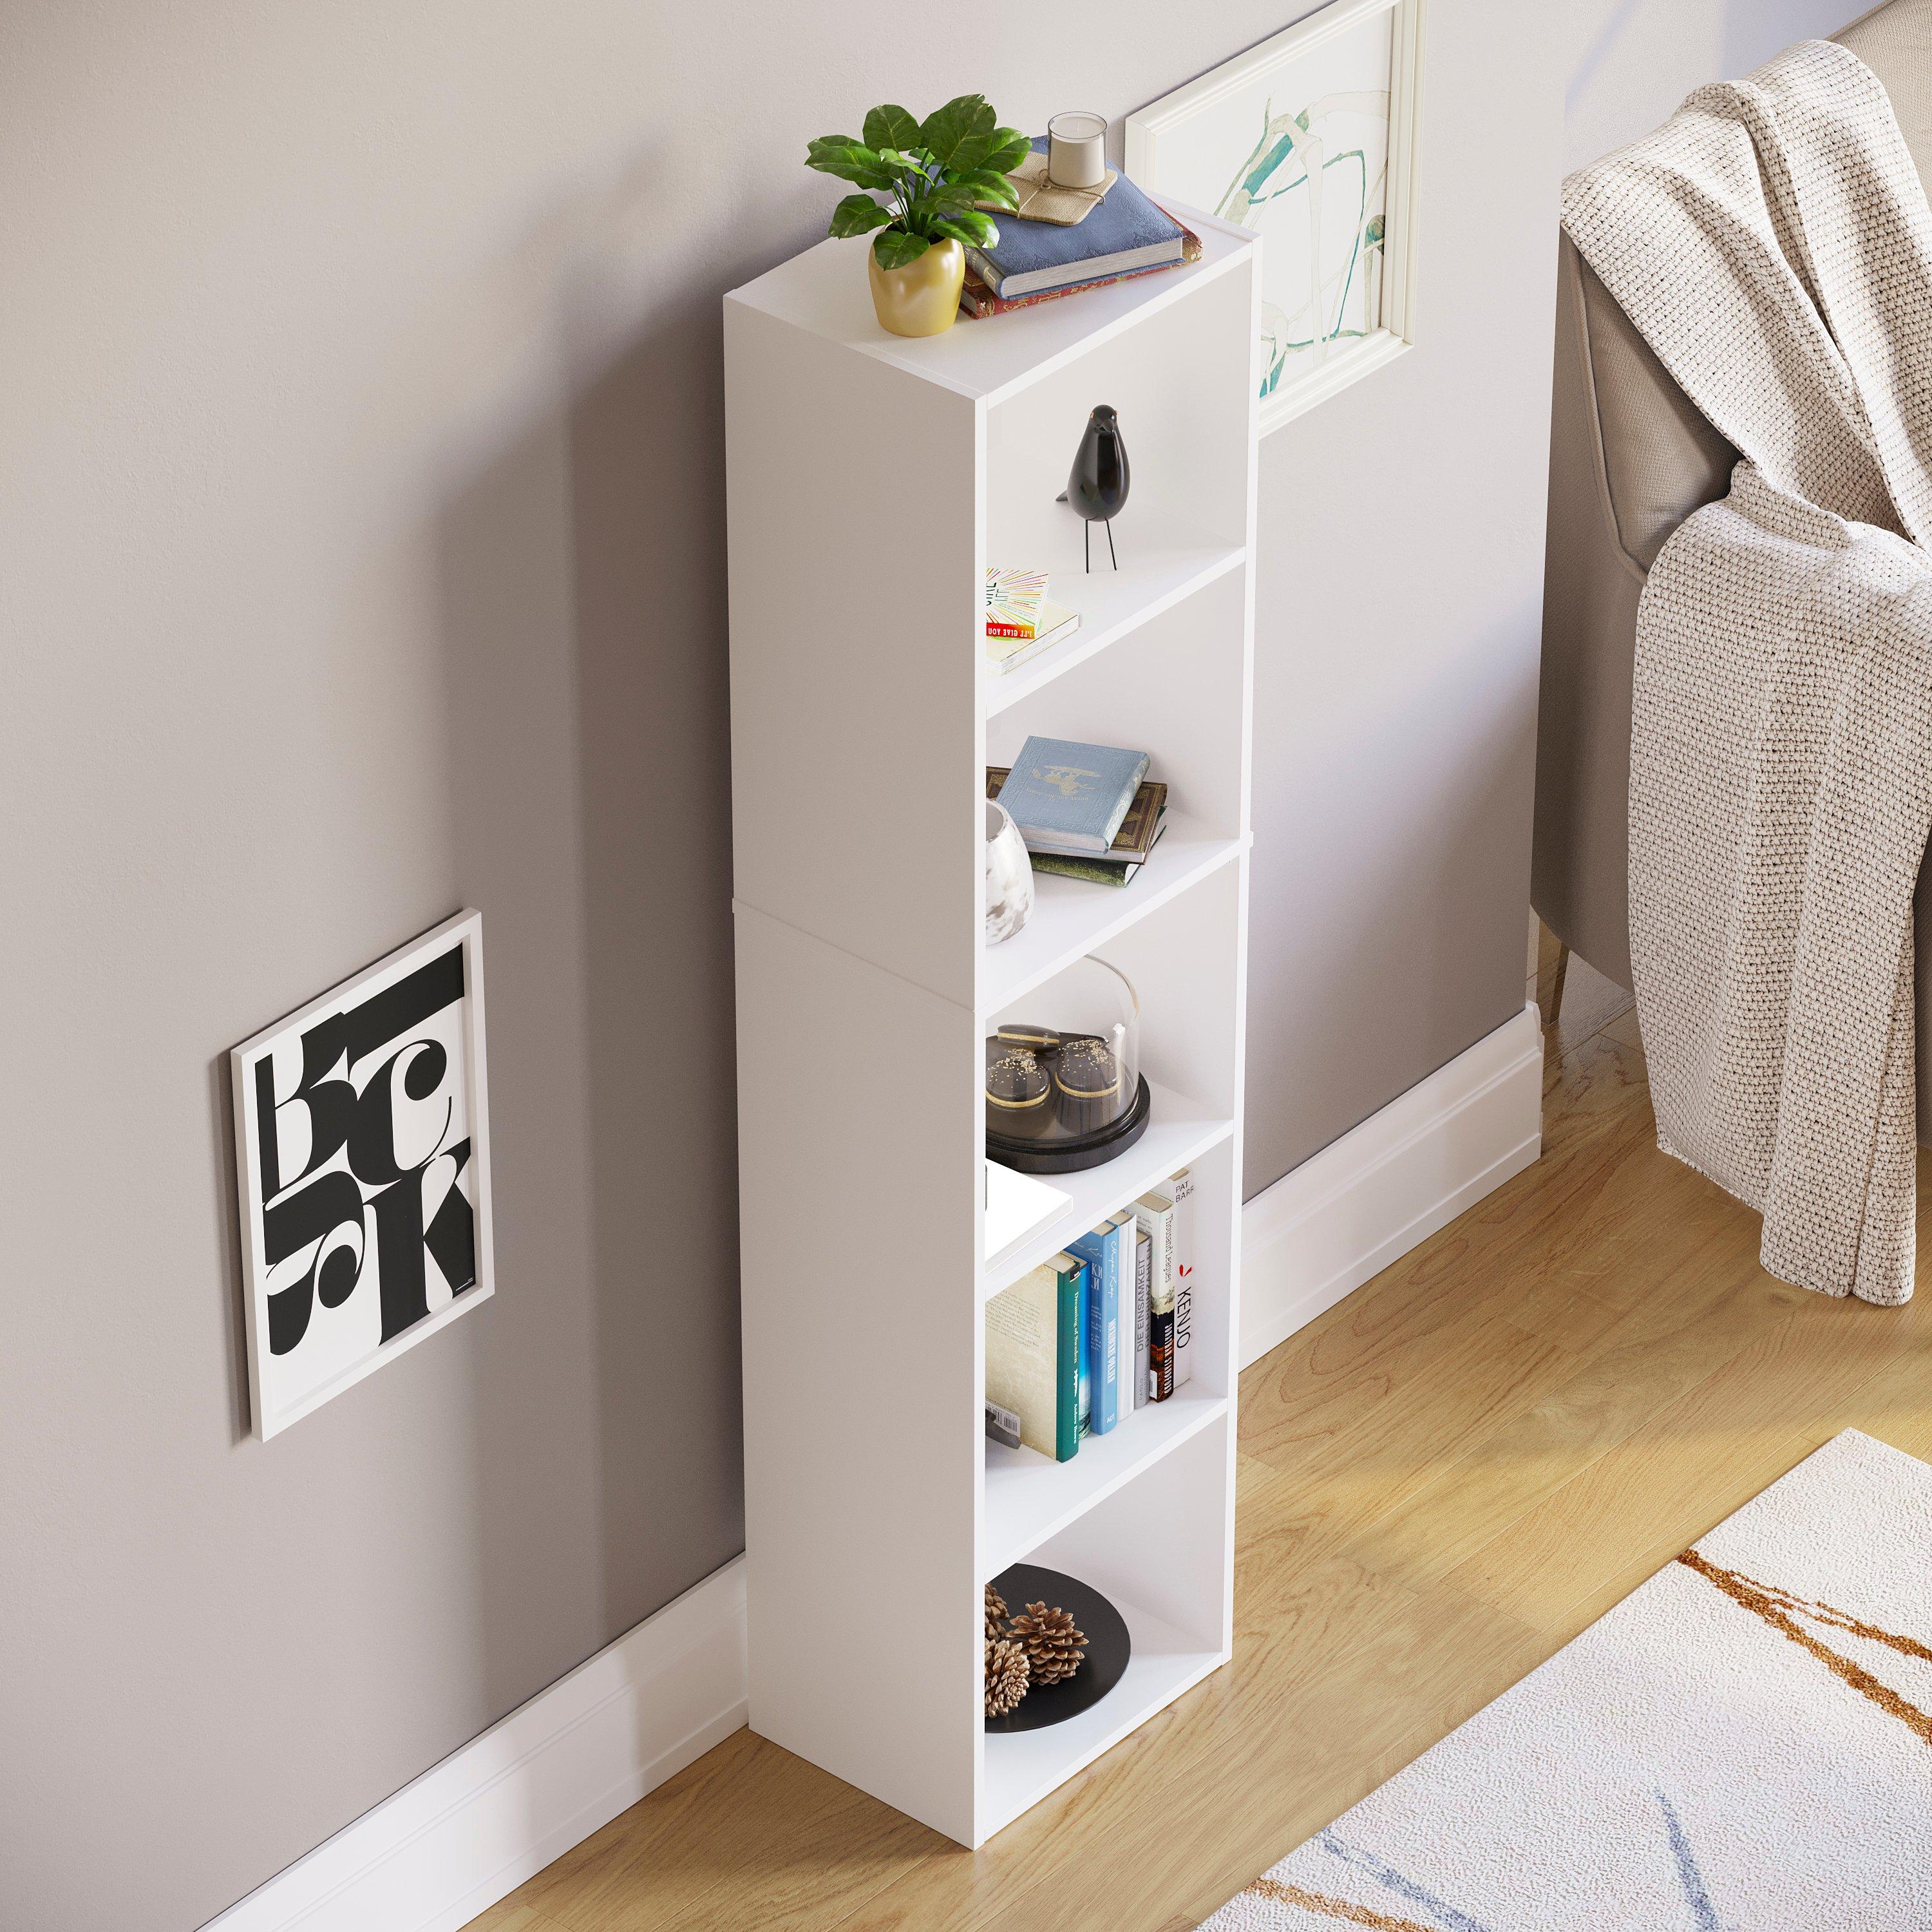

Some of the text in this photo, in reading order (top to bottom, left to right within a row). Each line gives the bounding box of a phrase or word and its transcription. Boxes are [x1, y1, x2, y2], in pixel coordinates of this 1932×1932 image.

[1176, 1180, 1189, 1193] PAT
[1164, 1251, 1173, 1283] Leagues
[1177, 1287, 1191, 1349] KENJO
